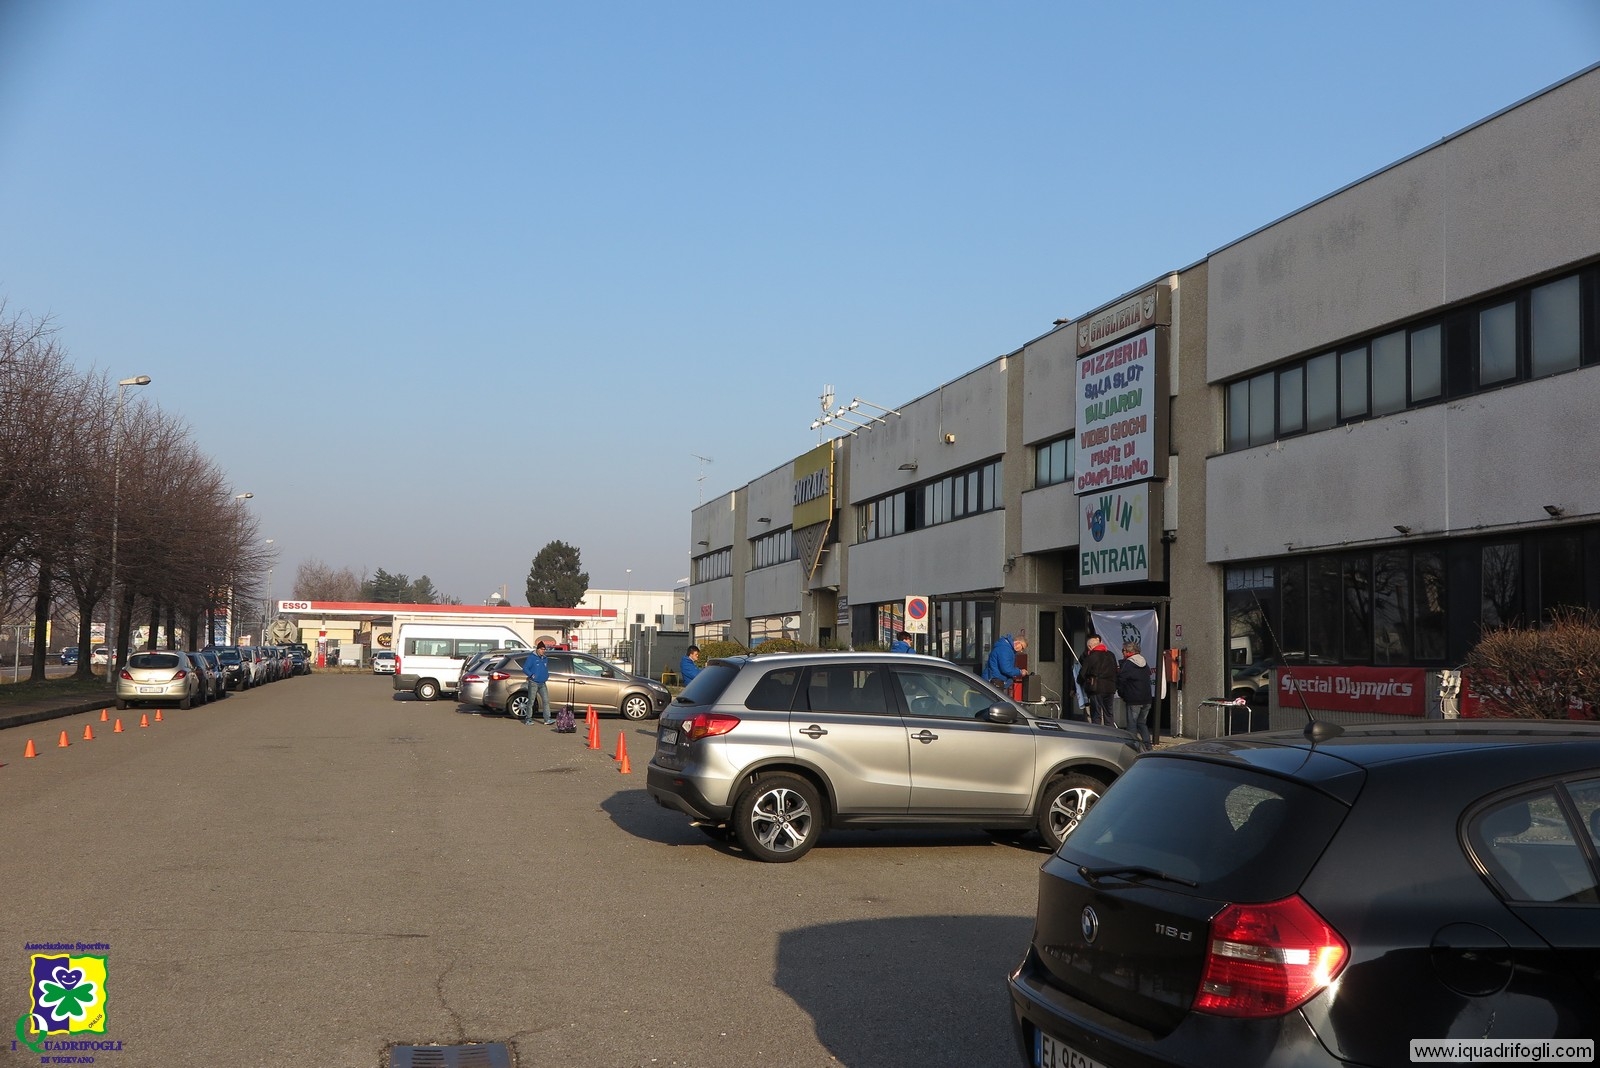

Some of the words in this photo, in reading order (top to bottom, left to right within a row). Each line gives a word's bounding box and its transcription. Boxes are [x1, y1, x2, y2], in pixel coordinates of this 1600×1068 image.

[1090, 303, 1141, 343] GRIGLIERIA
[1081, 337, 1148, 380] PIZZERIA
[1084, 375, 1112, 400] SALA
[1113, 363, 1144, 389] SLOT
[1085, 388, 1142, 425] BILIARDI
[1081, 425, 1109, 449] VIDEO
[1110, 414, 1147, 442] GIOCHI
[1090, 445, 1121, 467] FESTE
[1123, 440, 1135, 459] DI
[1077, 457, 1149, 490] COMPLEANNO
[1081, 544, 1147, 576] ENTRATA
[1281, 673, 1332, 695] Special
[1335, 677, 1413, 700] Olympics
